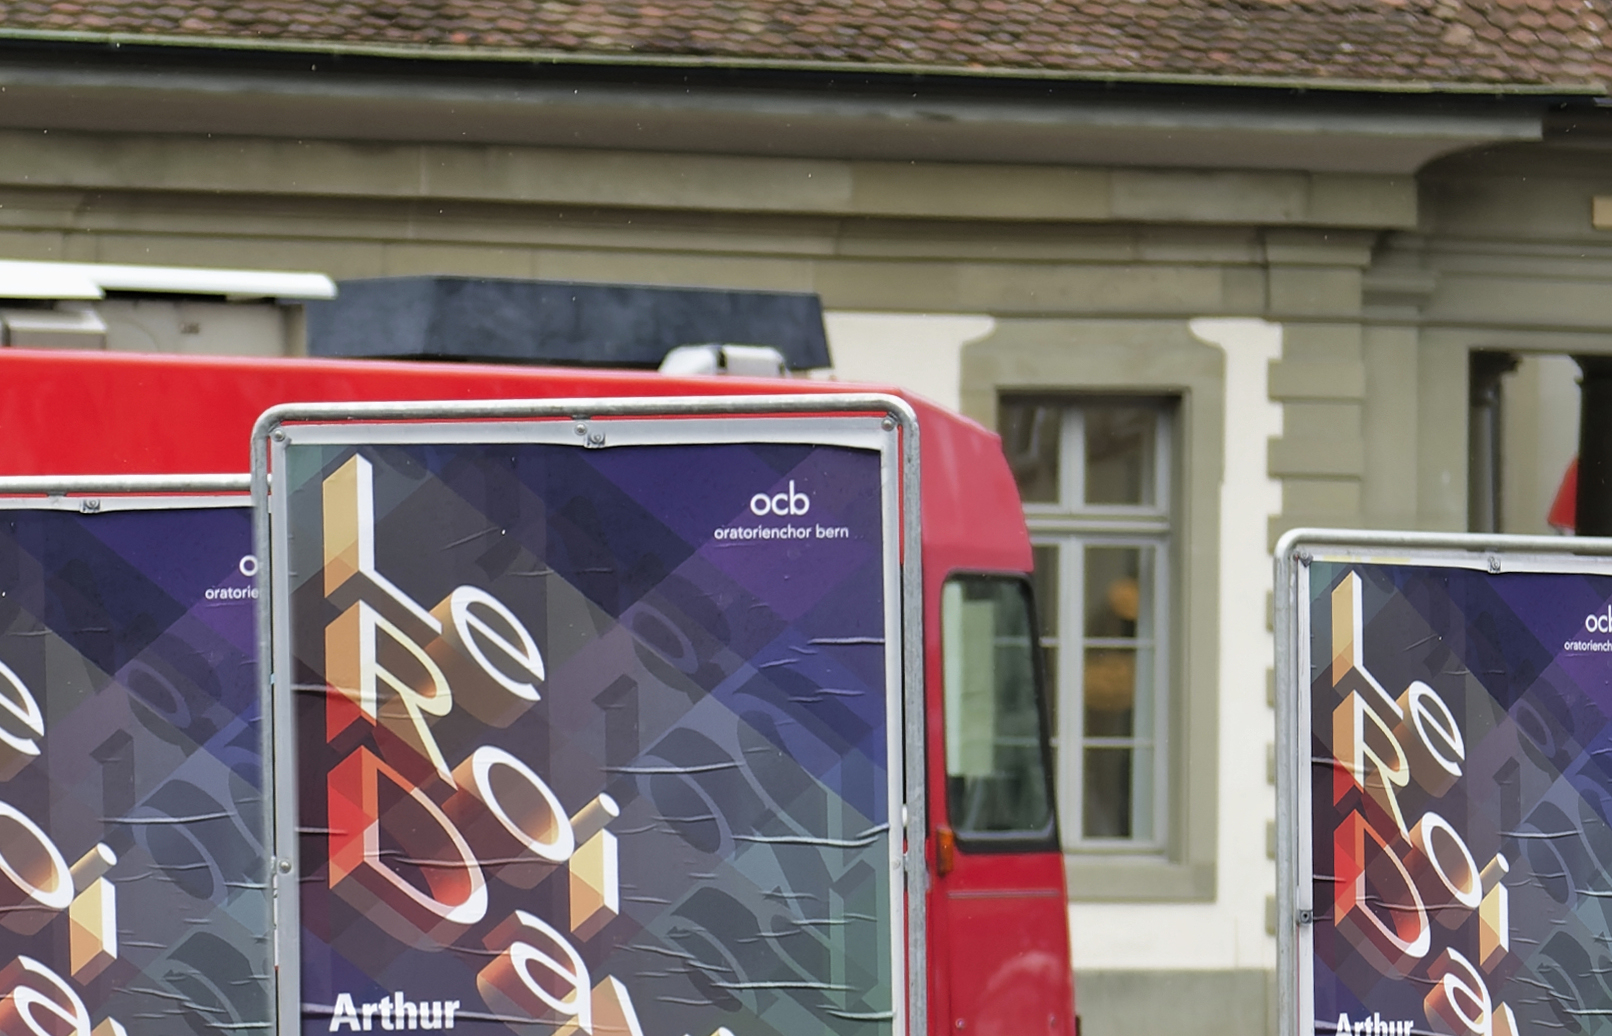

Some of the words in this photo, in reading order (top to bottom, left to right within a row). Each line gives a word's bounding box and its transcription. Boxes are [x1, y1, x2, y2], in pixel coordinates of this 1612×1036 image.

[749, 479, 810, 516] ocb
[713, 523, 812, 540] oratorienchor
[815, 523, 849, 538] bern
[204, 583, 258, 600] oratorie
[328, 990, 461, 1032] Arthur
